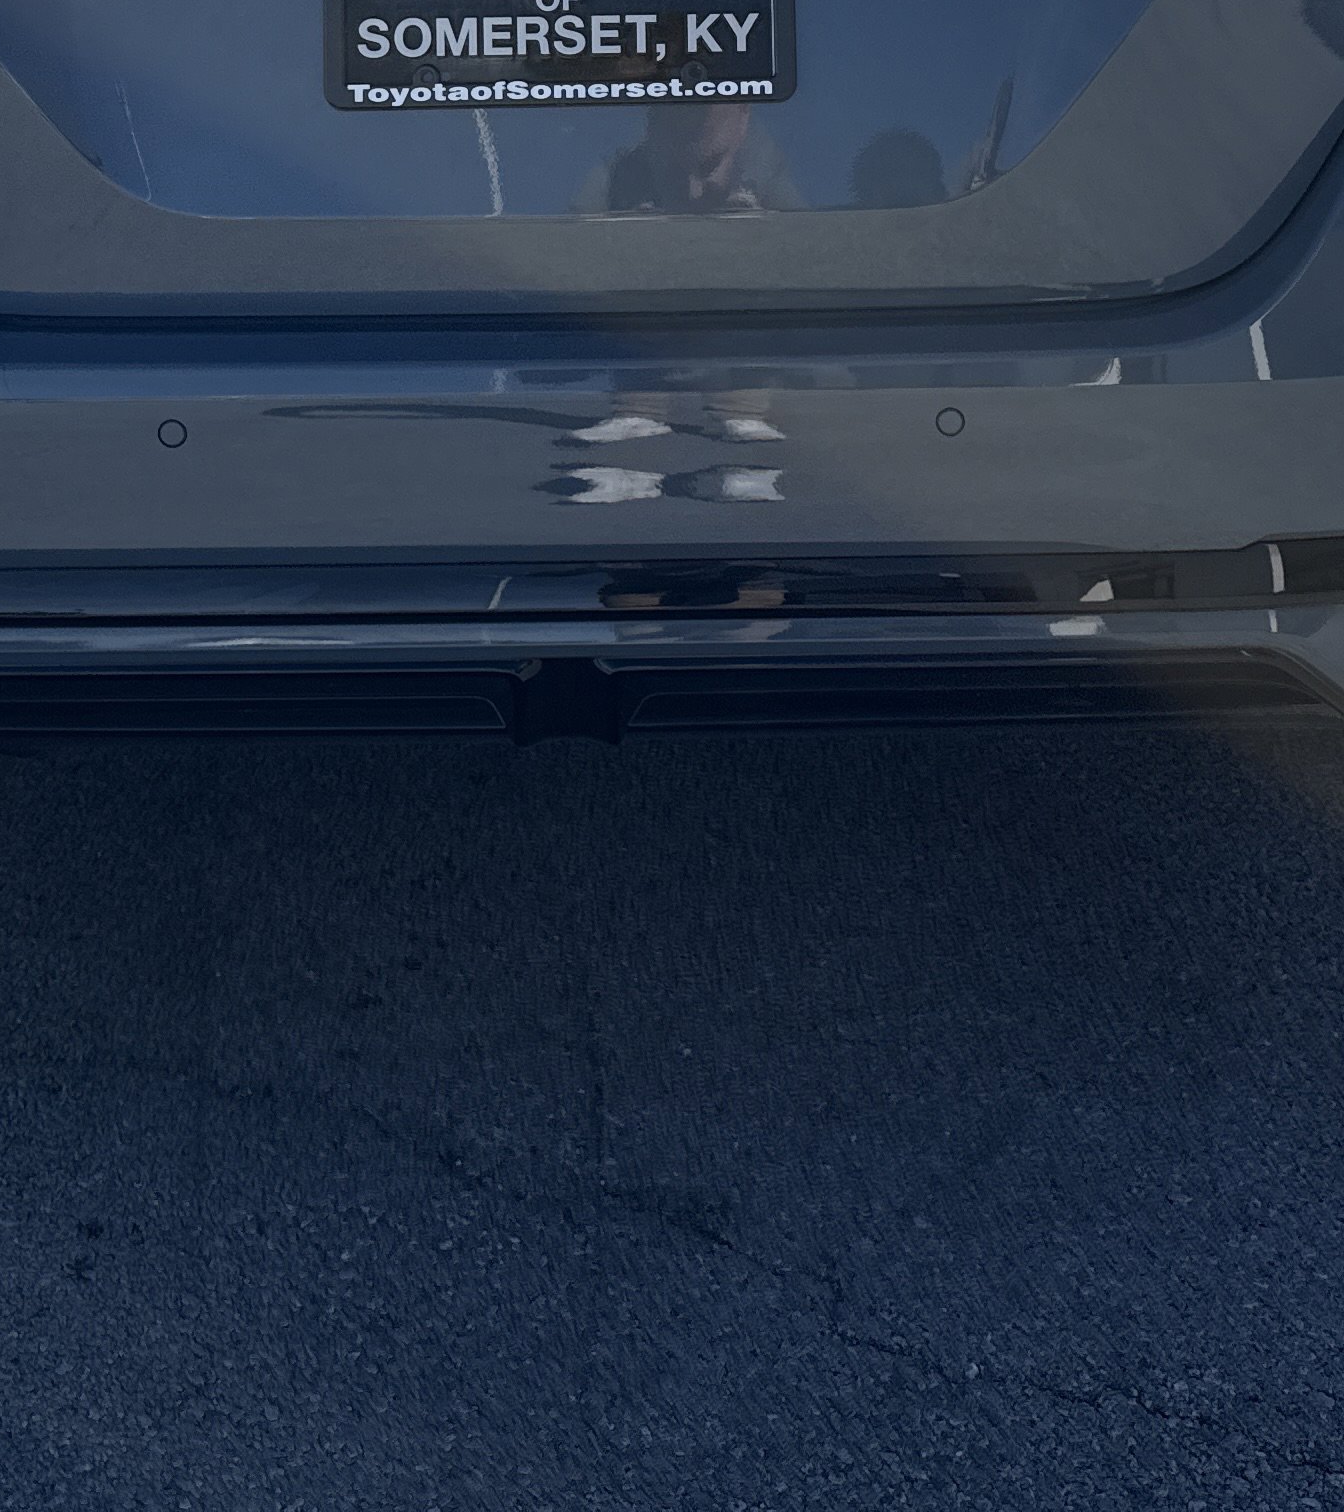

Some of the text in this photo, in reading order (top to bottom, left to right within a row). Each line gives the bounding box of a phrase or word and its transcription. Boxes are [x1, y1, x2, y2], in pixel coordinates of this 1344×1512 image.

[357, 13, 760, 62] SOMERSET, KY
[347, 77, 773, 107] ToyotaofSomerset.com
